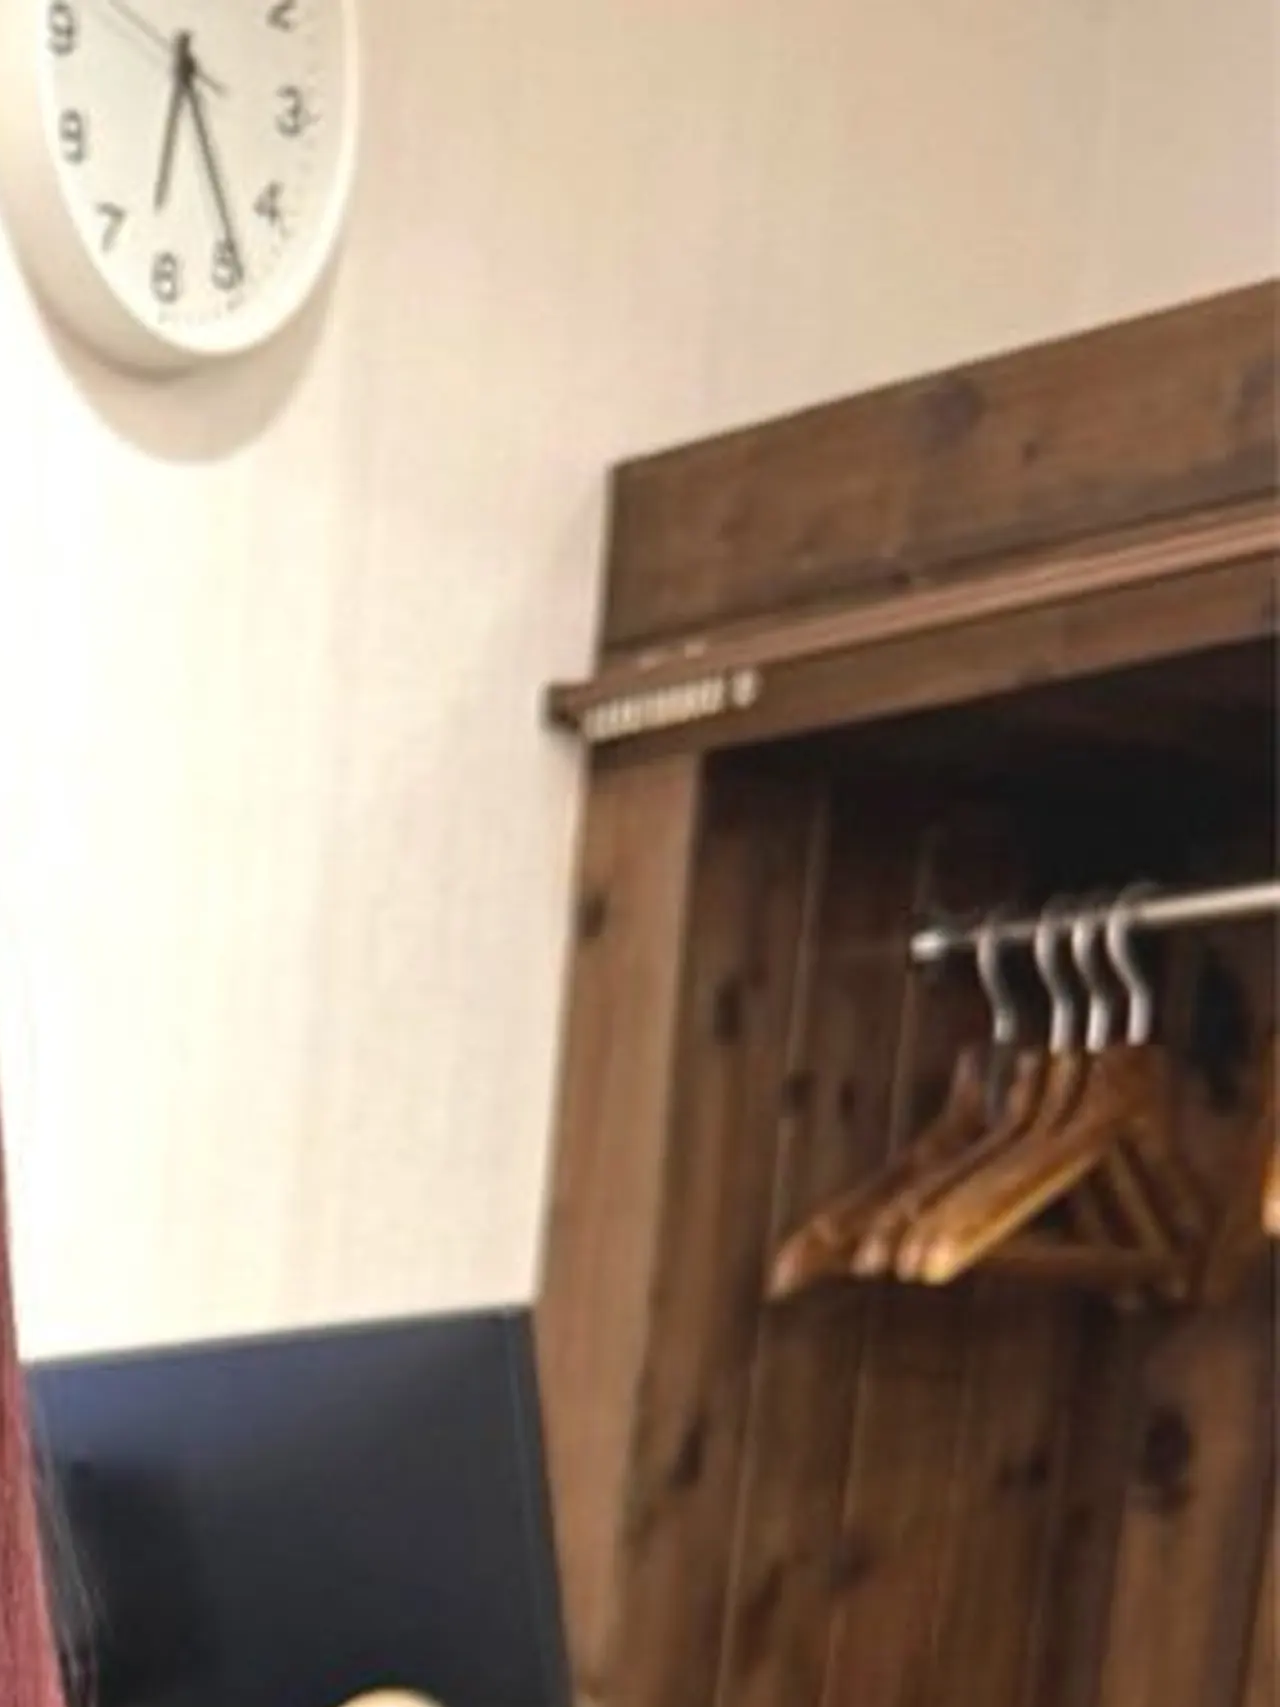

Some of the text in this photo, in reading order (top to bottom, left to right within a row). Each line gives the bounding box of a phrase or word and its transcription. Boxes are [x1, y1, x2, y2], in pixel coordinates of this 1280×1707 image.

[47, 1, 76, 56] 9
[276, 84, 304, 138] 3
[95, 202, 127, 253] 7
[253, 180, 284, 226] 4
[150, 250, 179, 304] 6
